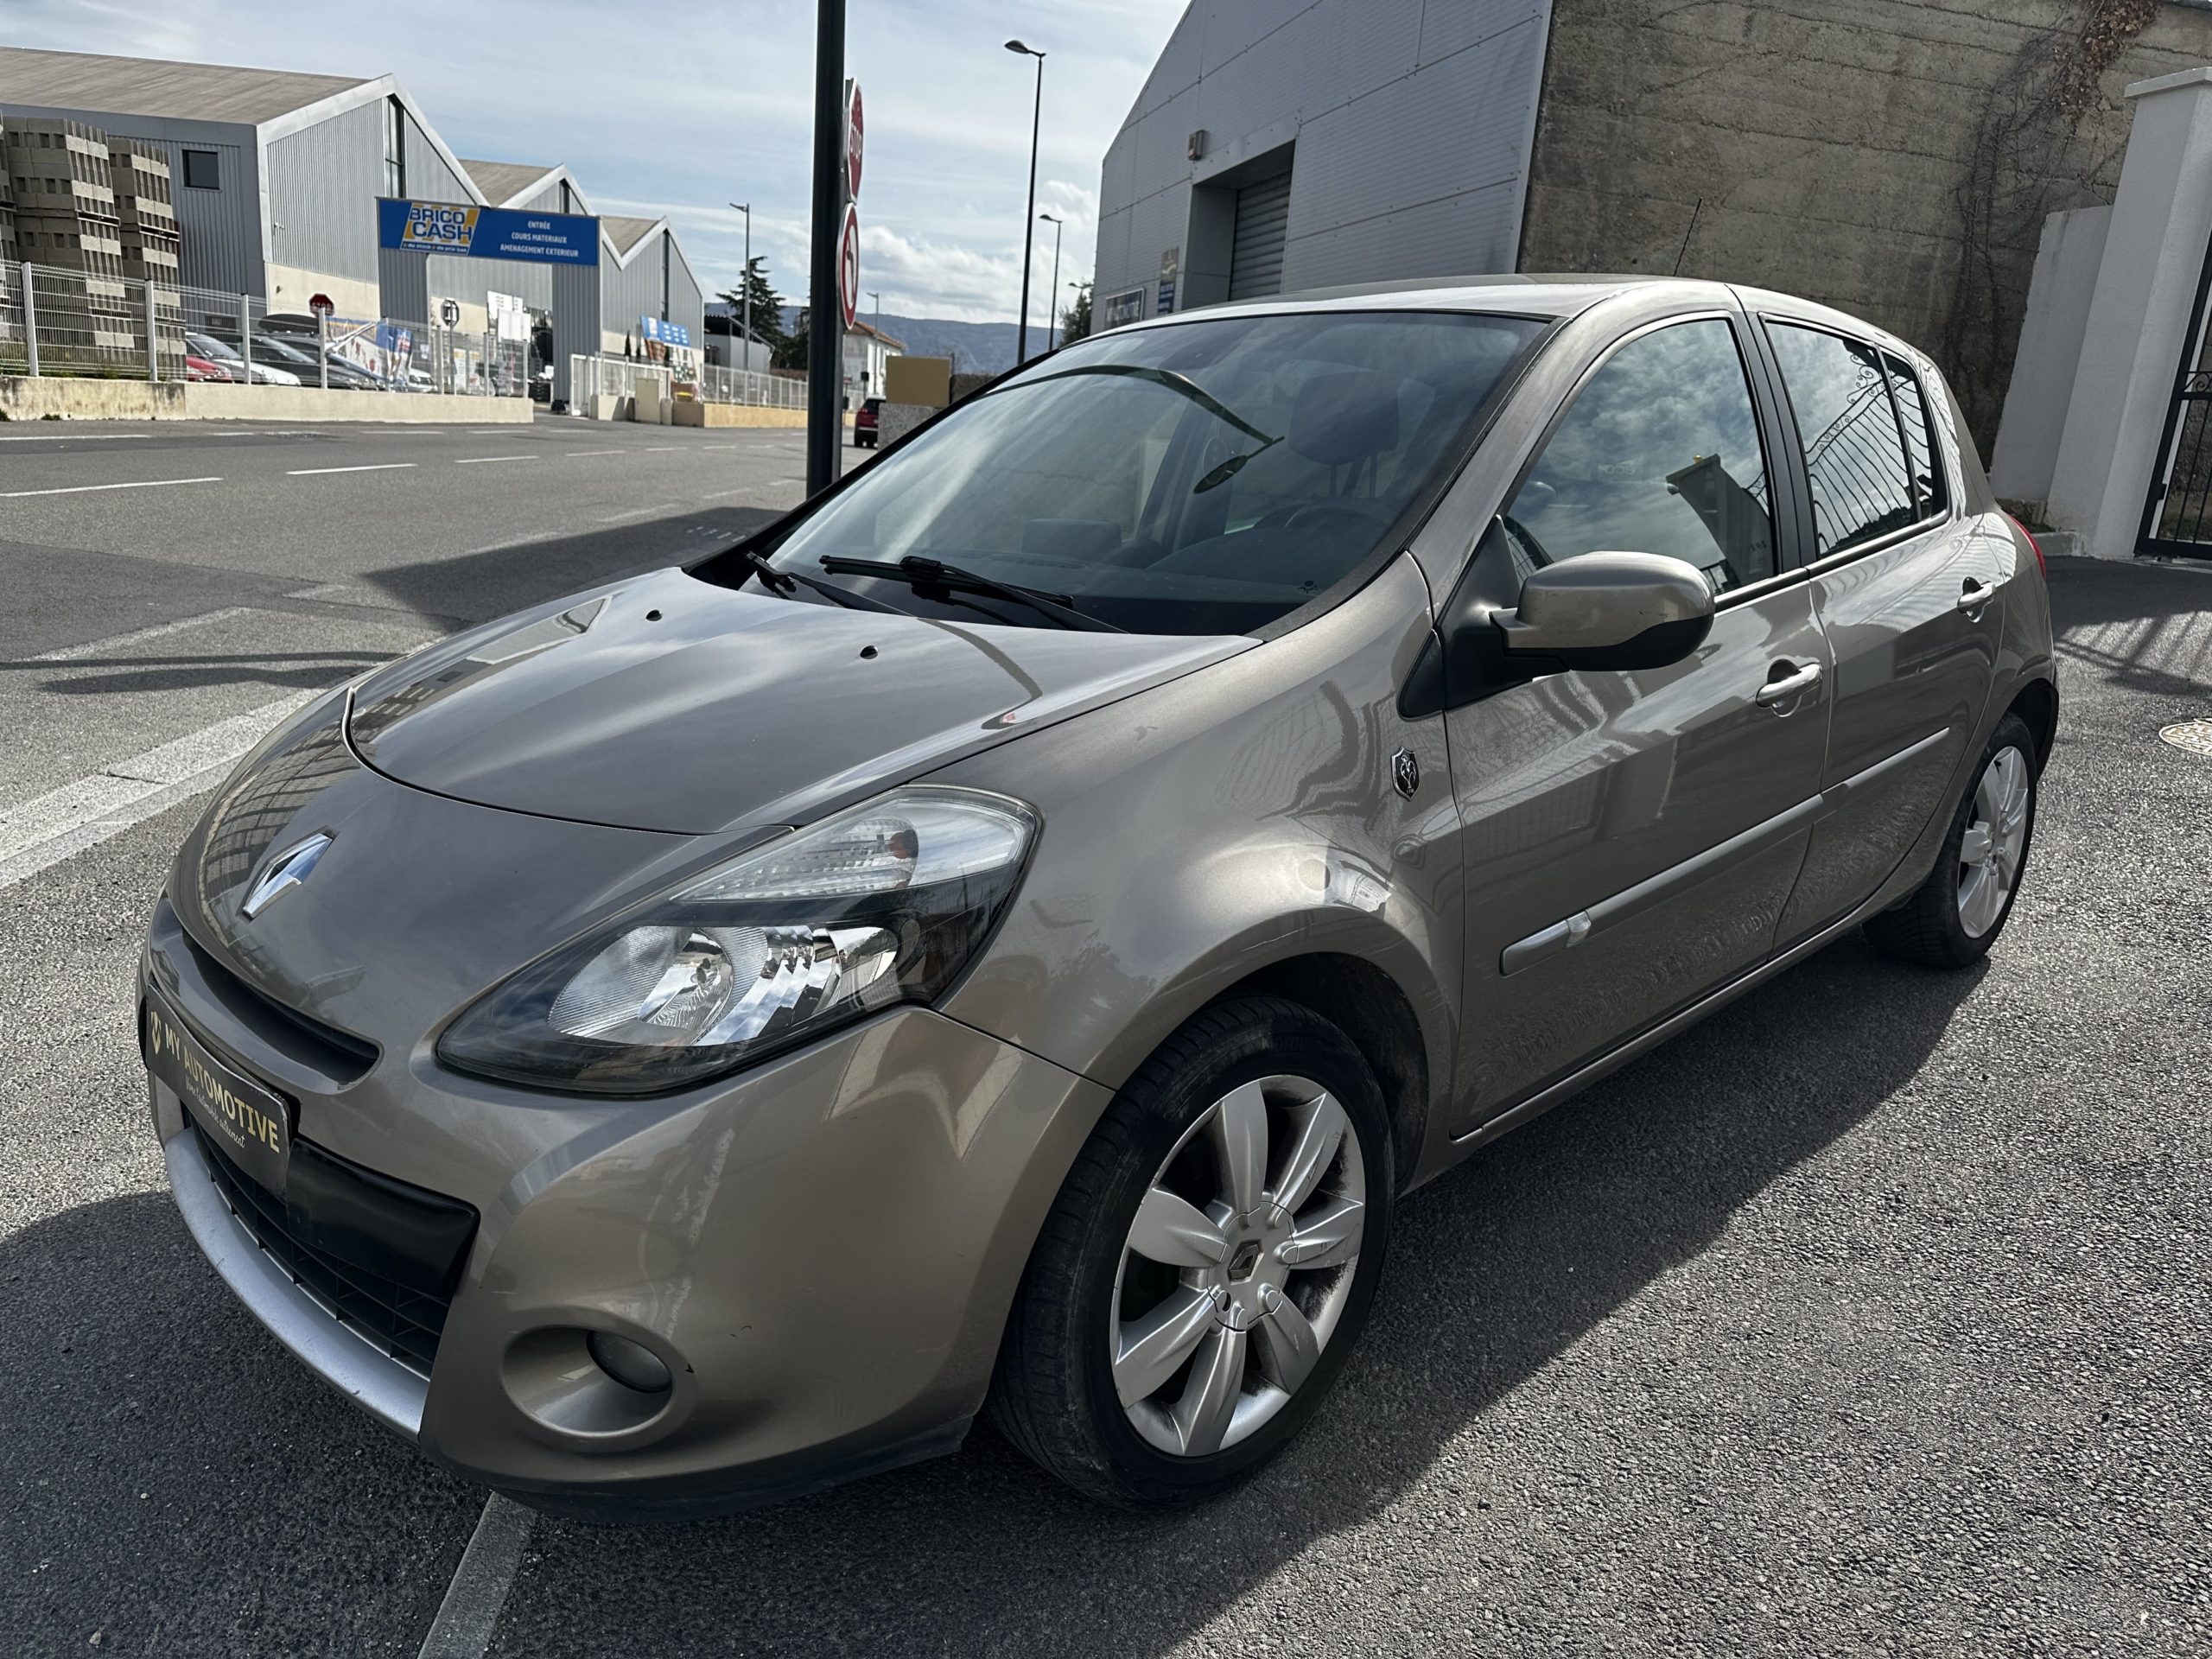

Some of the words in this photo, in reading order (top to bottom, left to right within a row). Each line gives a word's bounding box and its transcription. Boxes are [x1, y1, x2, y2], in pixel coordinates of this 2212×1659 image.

[410, 207, 465, 224] BRICO
[413, 222, 472, 241] CASH
[527, 220, 551, 230] ENTRÉE
[511, 232, 531, 241] COURS
[532, 234, 568, 244] MATERIAUX
[499, 244, 545, 254] AMENAGEMENT
[545, 247, 579, 257] EXTERIEUR
[165, 1023, 181, 1060] MY
[184, 1046, 280, 1154] AUTOMOTIVE
